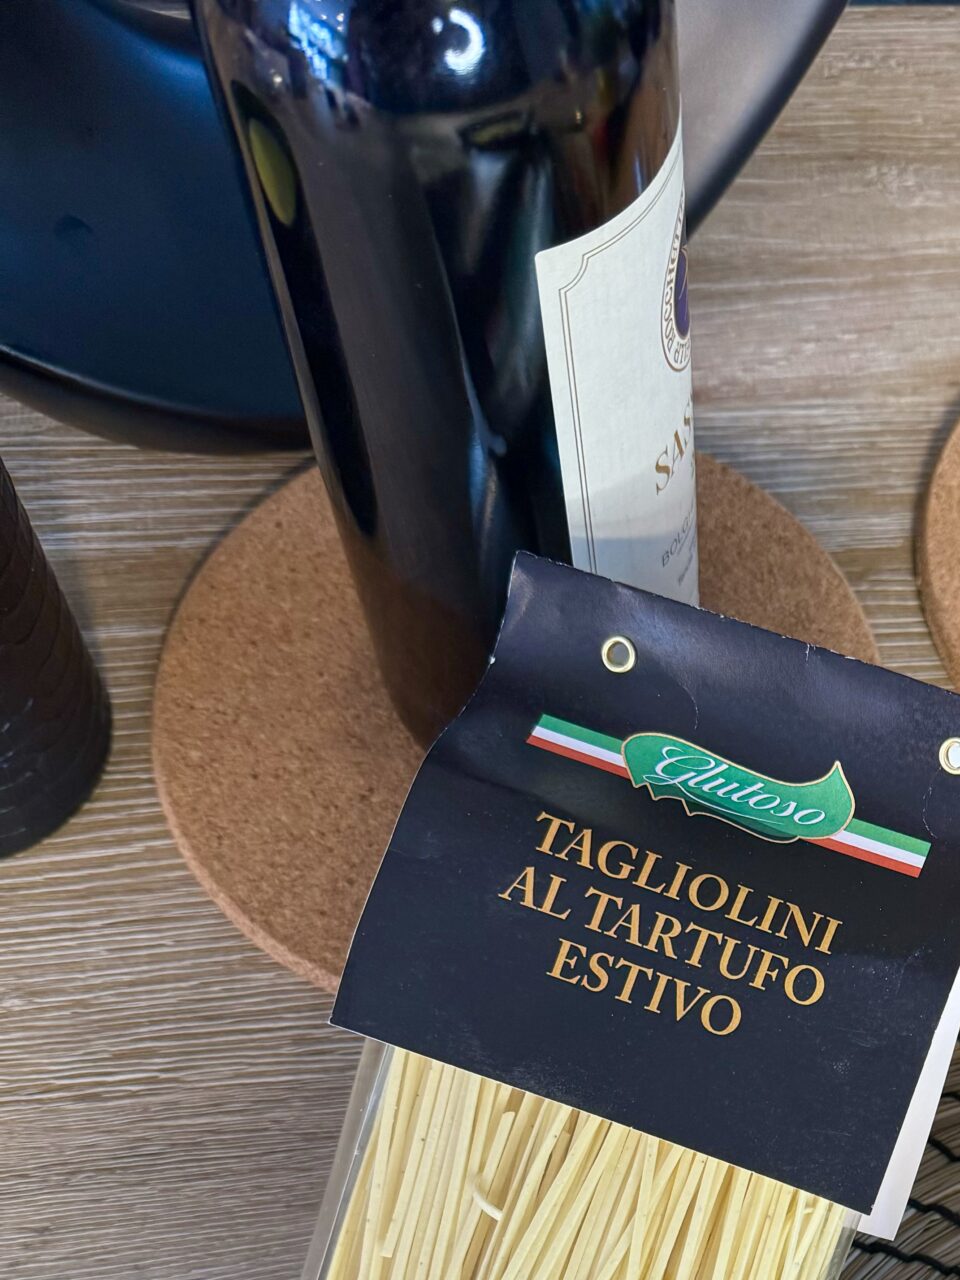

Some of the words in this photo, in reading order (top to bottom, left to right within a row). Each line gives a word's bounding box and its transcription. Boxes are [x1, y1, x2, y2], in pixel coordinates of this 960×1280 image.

[655, 390, 694, 496] SAS
[642, 745, 827, 826] Glutoso
[498, 865, 573, 921] AL
[584, 886, 826, 1006] TARTUFO
[534, 811, 843, 956] TAGLIOLINI
[546, 938, 743, 1037] ESTIVO
